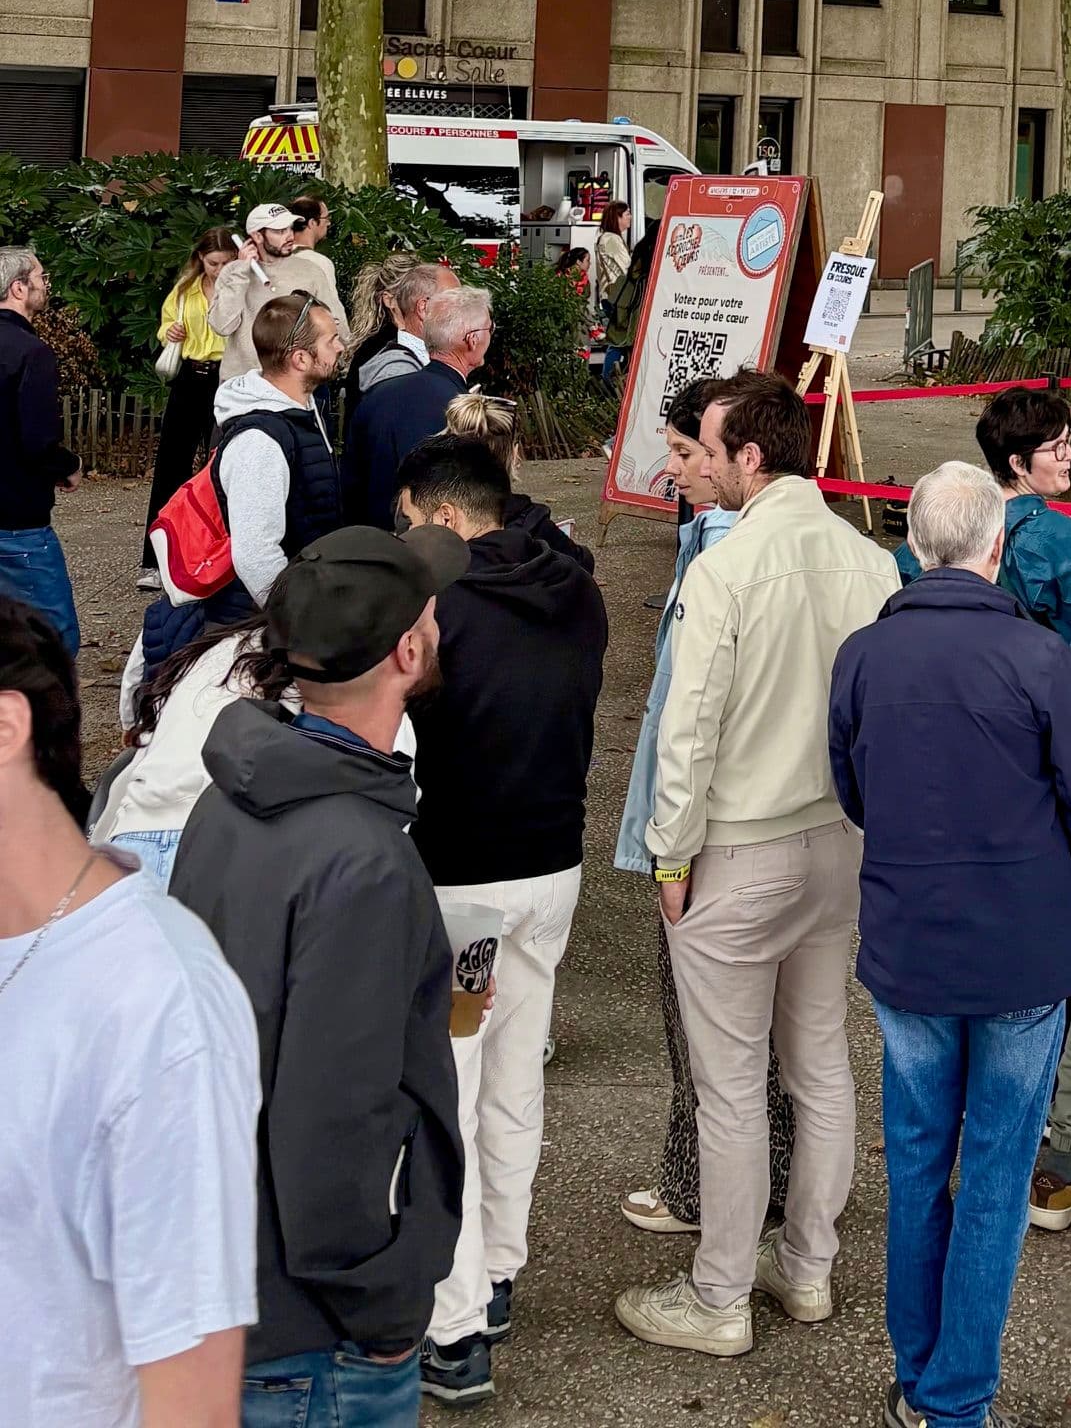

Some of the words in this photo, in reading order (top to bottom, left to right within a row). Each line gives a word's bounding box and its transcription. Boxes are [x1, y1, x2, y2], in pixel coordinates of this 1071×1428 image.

[455, 59, 505, 84] Salle
[438, 127, 500, 139] PERSONNES
[830, 261, 868, 278] FRESQUE
[674, 293, 696, 306] Votez
[697, 297, 719, 310] pour
[720, 298, 744, 309] votre
[662, 307, 689, 320] artiste
[690, 311, 711, 324] coup
[712, 310, 724, 322] de
[726, 314, 749, 325] cœur
